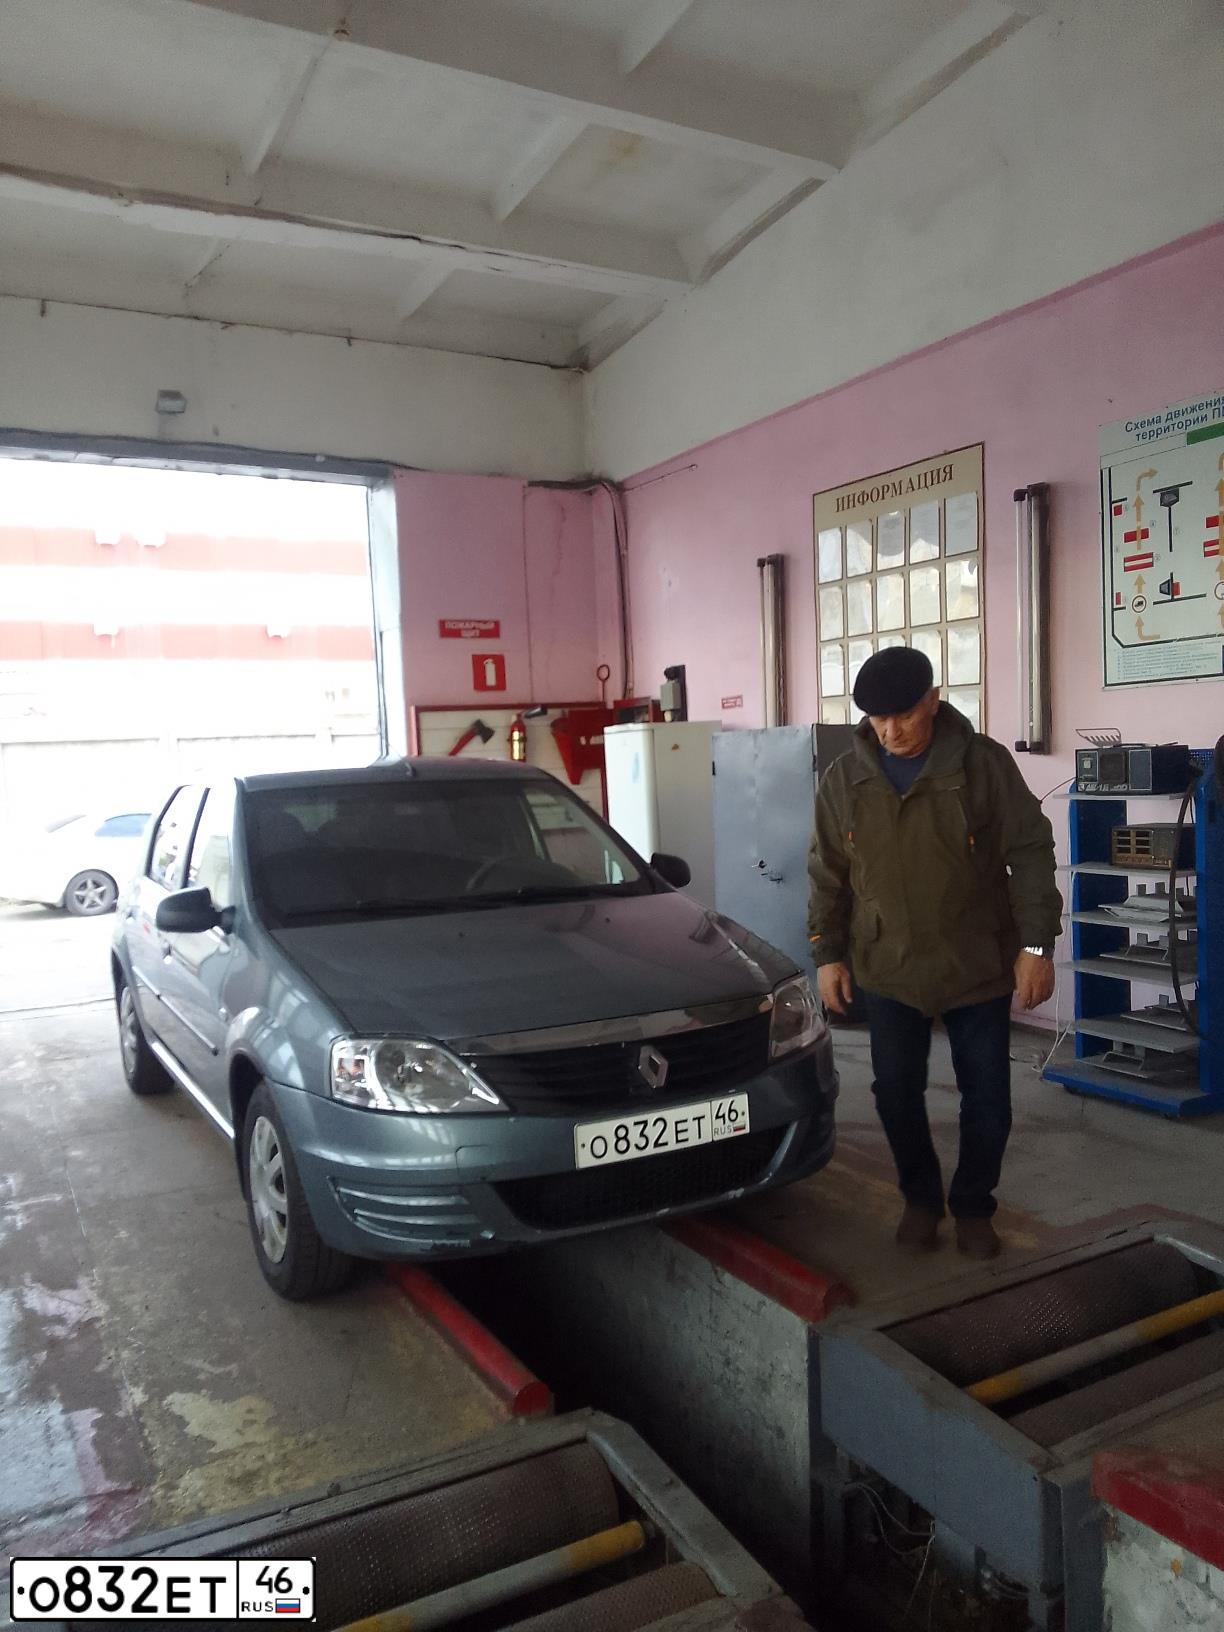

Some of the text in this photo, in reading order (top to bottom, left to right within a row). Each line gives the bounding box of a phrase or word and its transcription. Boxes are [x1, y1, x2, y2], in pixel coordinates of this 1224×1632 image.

[1125, 414, 1162, 433] Схема
[1135, 406, 1224, 442] территории П
[835, 463, 954, 513] ИНФОРМАЦИЯ
[714, 1099, 739, 1125] 46
[713, 1124, 732, 1137] RUS
